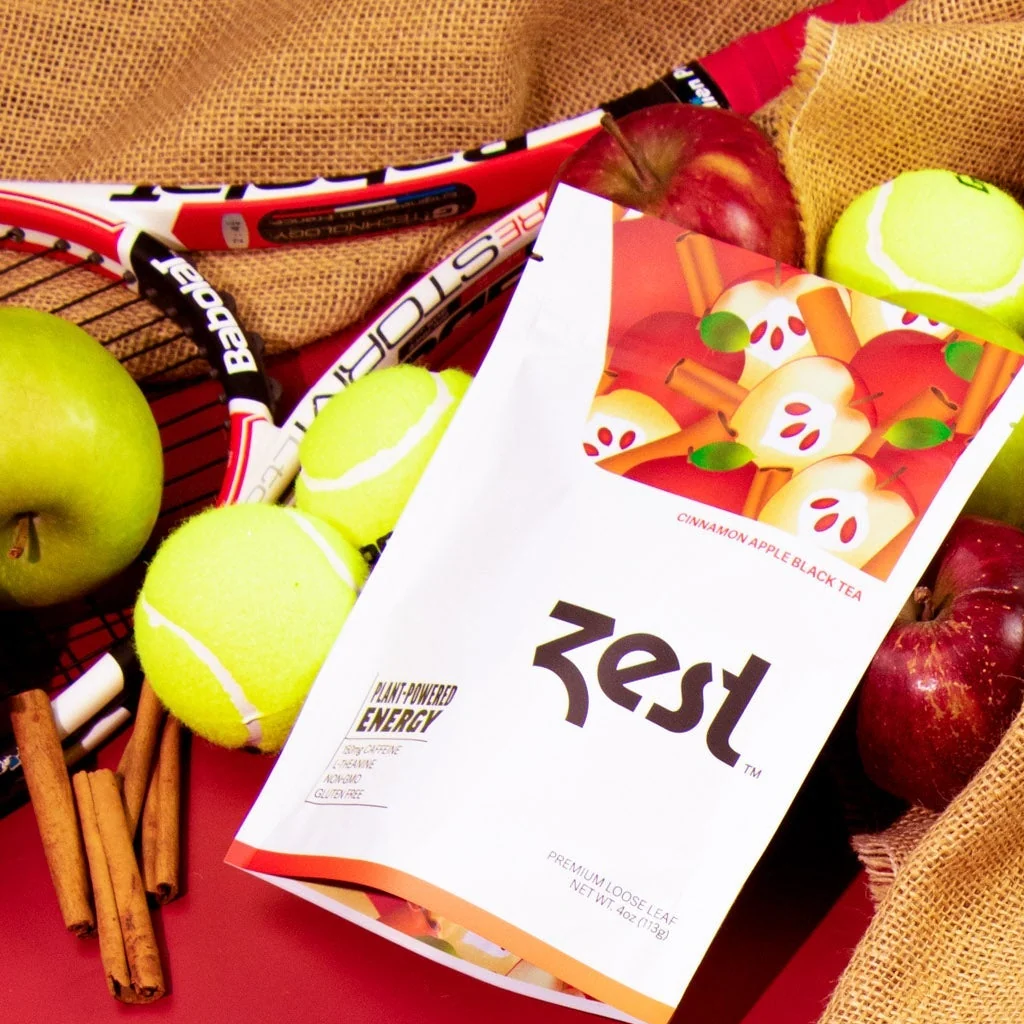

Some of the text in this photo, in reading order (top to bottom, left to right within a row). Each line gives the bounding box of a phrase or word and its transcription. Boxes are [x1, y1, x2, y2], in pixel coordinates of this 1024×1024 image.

[150, 256, 258, 375] Babolat
[676, 512, 862, 602] CINNAMON APPLE BLACK TEA
[370, 681, 458, 706] PLANT-POWERED
[533, 600, 772, 768] zest
[356, 707, 444, 733] ENERGY
[363, 744, 404, 755] CAFFEINE
[332, 758, 377, 770] L-THEANINE
[323, 773, 362, 785] NON-GMO
[314, 788, 365, 800] GLUTEN FREE
[547, 850, 678, 926] PREMIUM LOOSE LEAF
[569, 879, 670, 942] NET WT. 4oz (113g)
